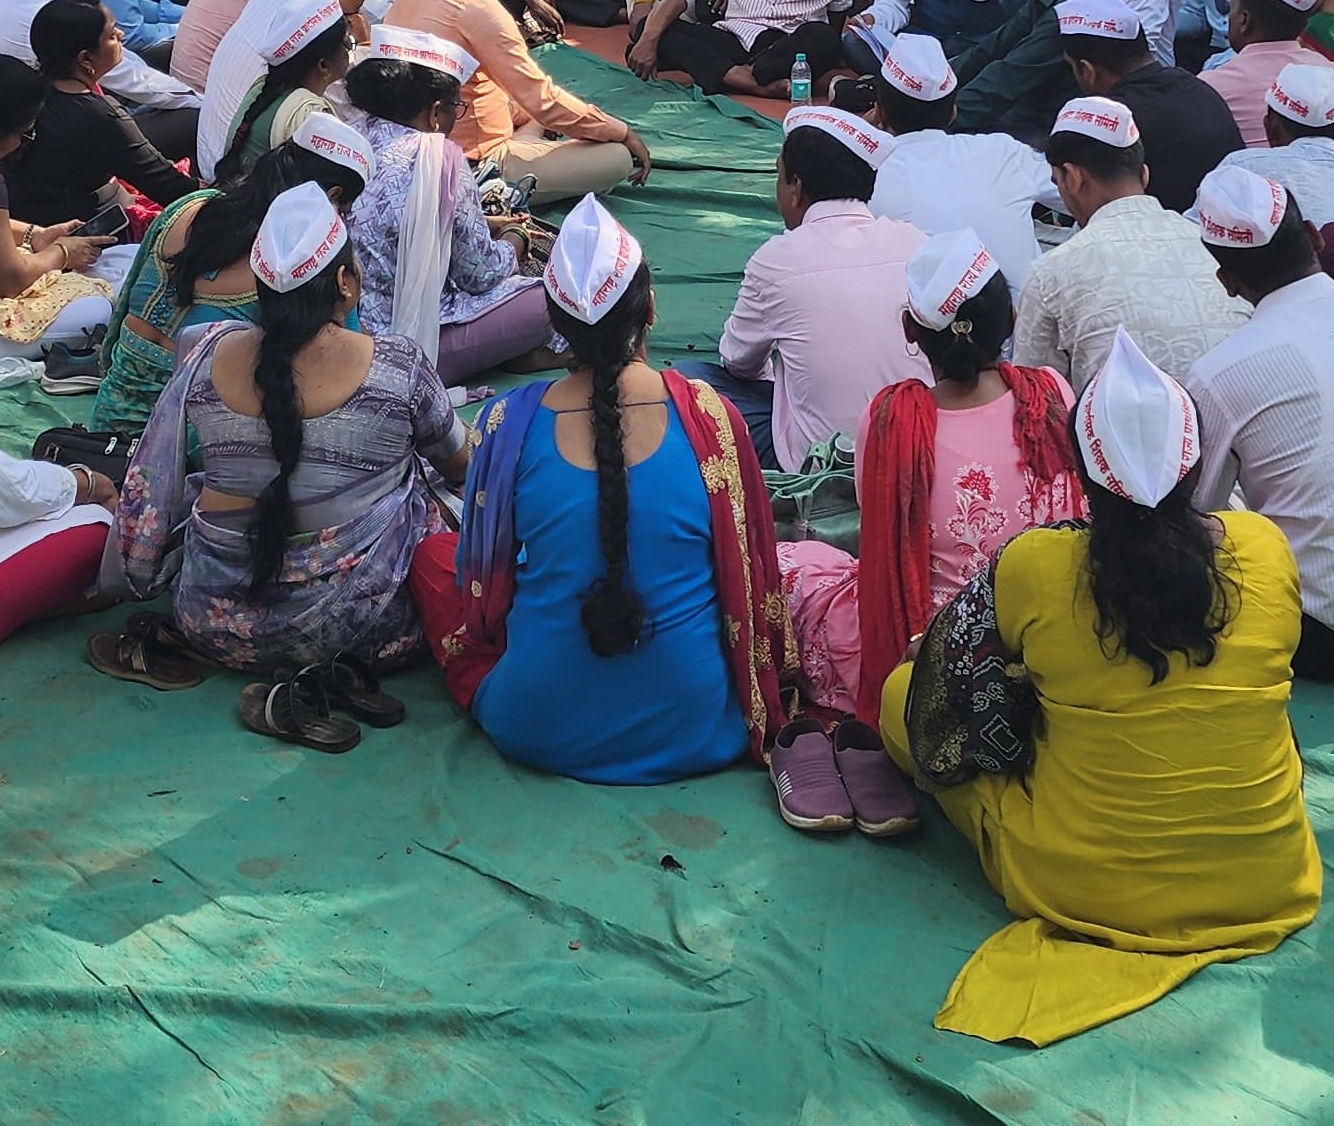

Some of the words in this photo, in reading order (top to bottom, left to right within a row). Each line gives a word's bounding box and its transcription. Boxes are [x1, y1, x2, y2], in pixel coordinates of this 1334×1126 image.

[1094, 113, 1119, 133] समिती
[310, 134, 336, 154] महाराष्ट्र
[337, 142, 351, 156] राज्य
[857, 133, 880, 155] समिती
[1227, 225, 1254, 244] समिती
[290, 259, 317, 281] महाराष्ट्र
[314, 243, 330, 260] राज्य
[592, 275, 615, 306] महाराष्ट्र
[613, 251, 627, 276] राज्य
[938, 286, 968, 316] महाराष्ट्र
[959, 269, 978, 289] राज्य
